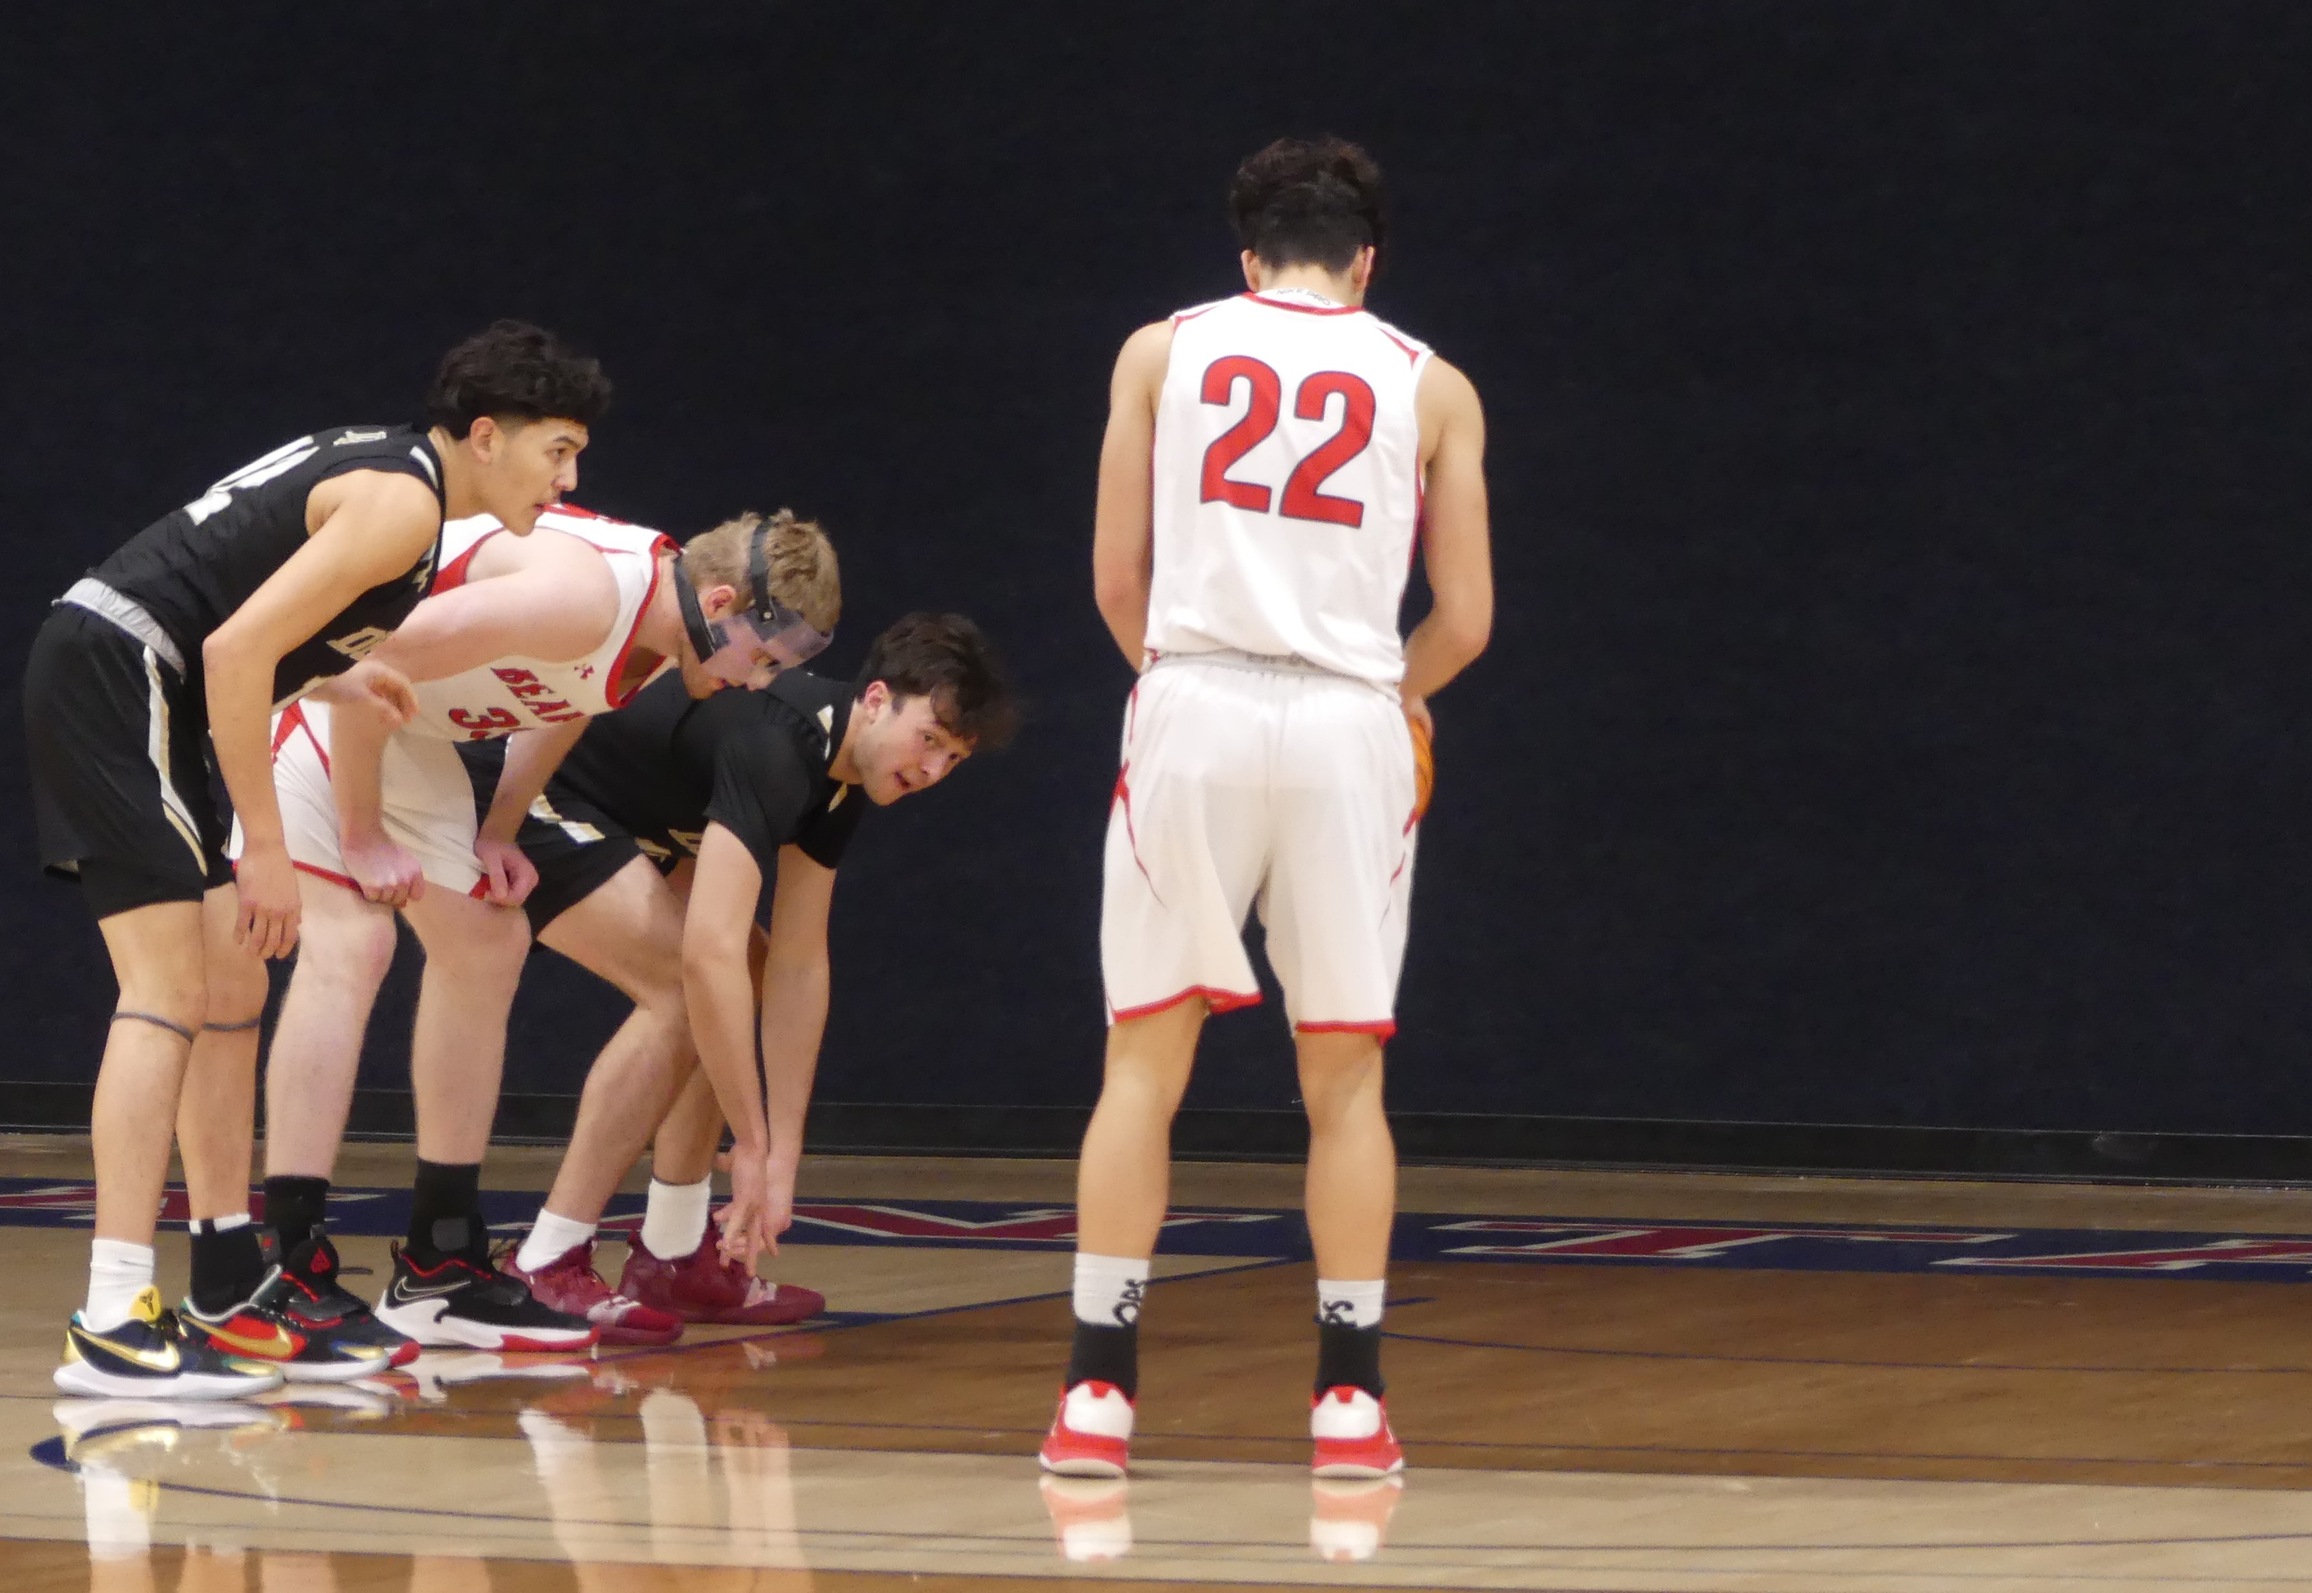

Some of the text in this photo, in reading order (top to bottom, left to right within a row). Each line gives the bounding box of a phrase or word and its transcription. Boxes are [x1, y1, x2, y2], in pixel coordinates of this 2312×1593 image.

[1306, 290, 1331, 306] PRO
[1200, 354, 1376, 529] 22
[449, 707, 535, 740] 3
